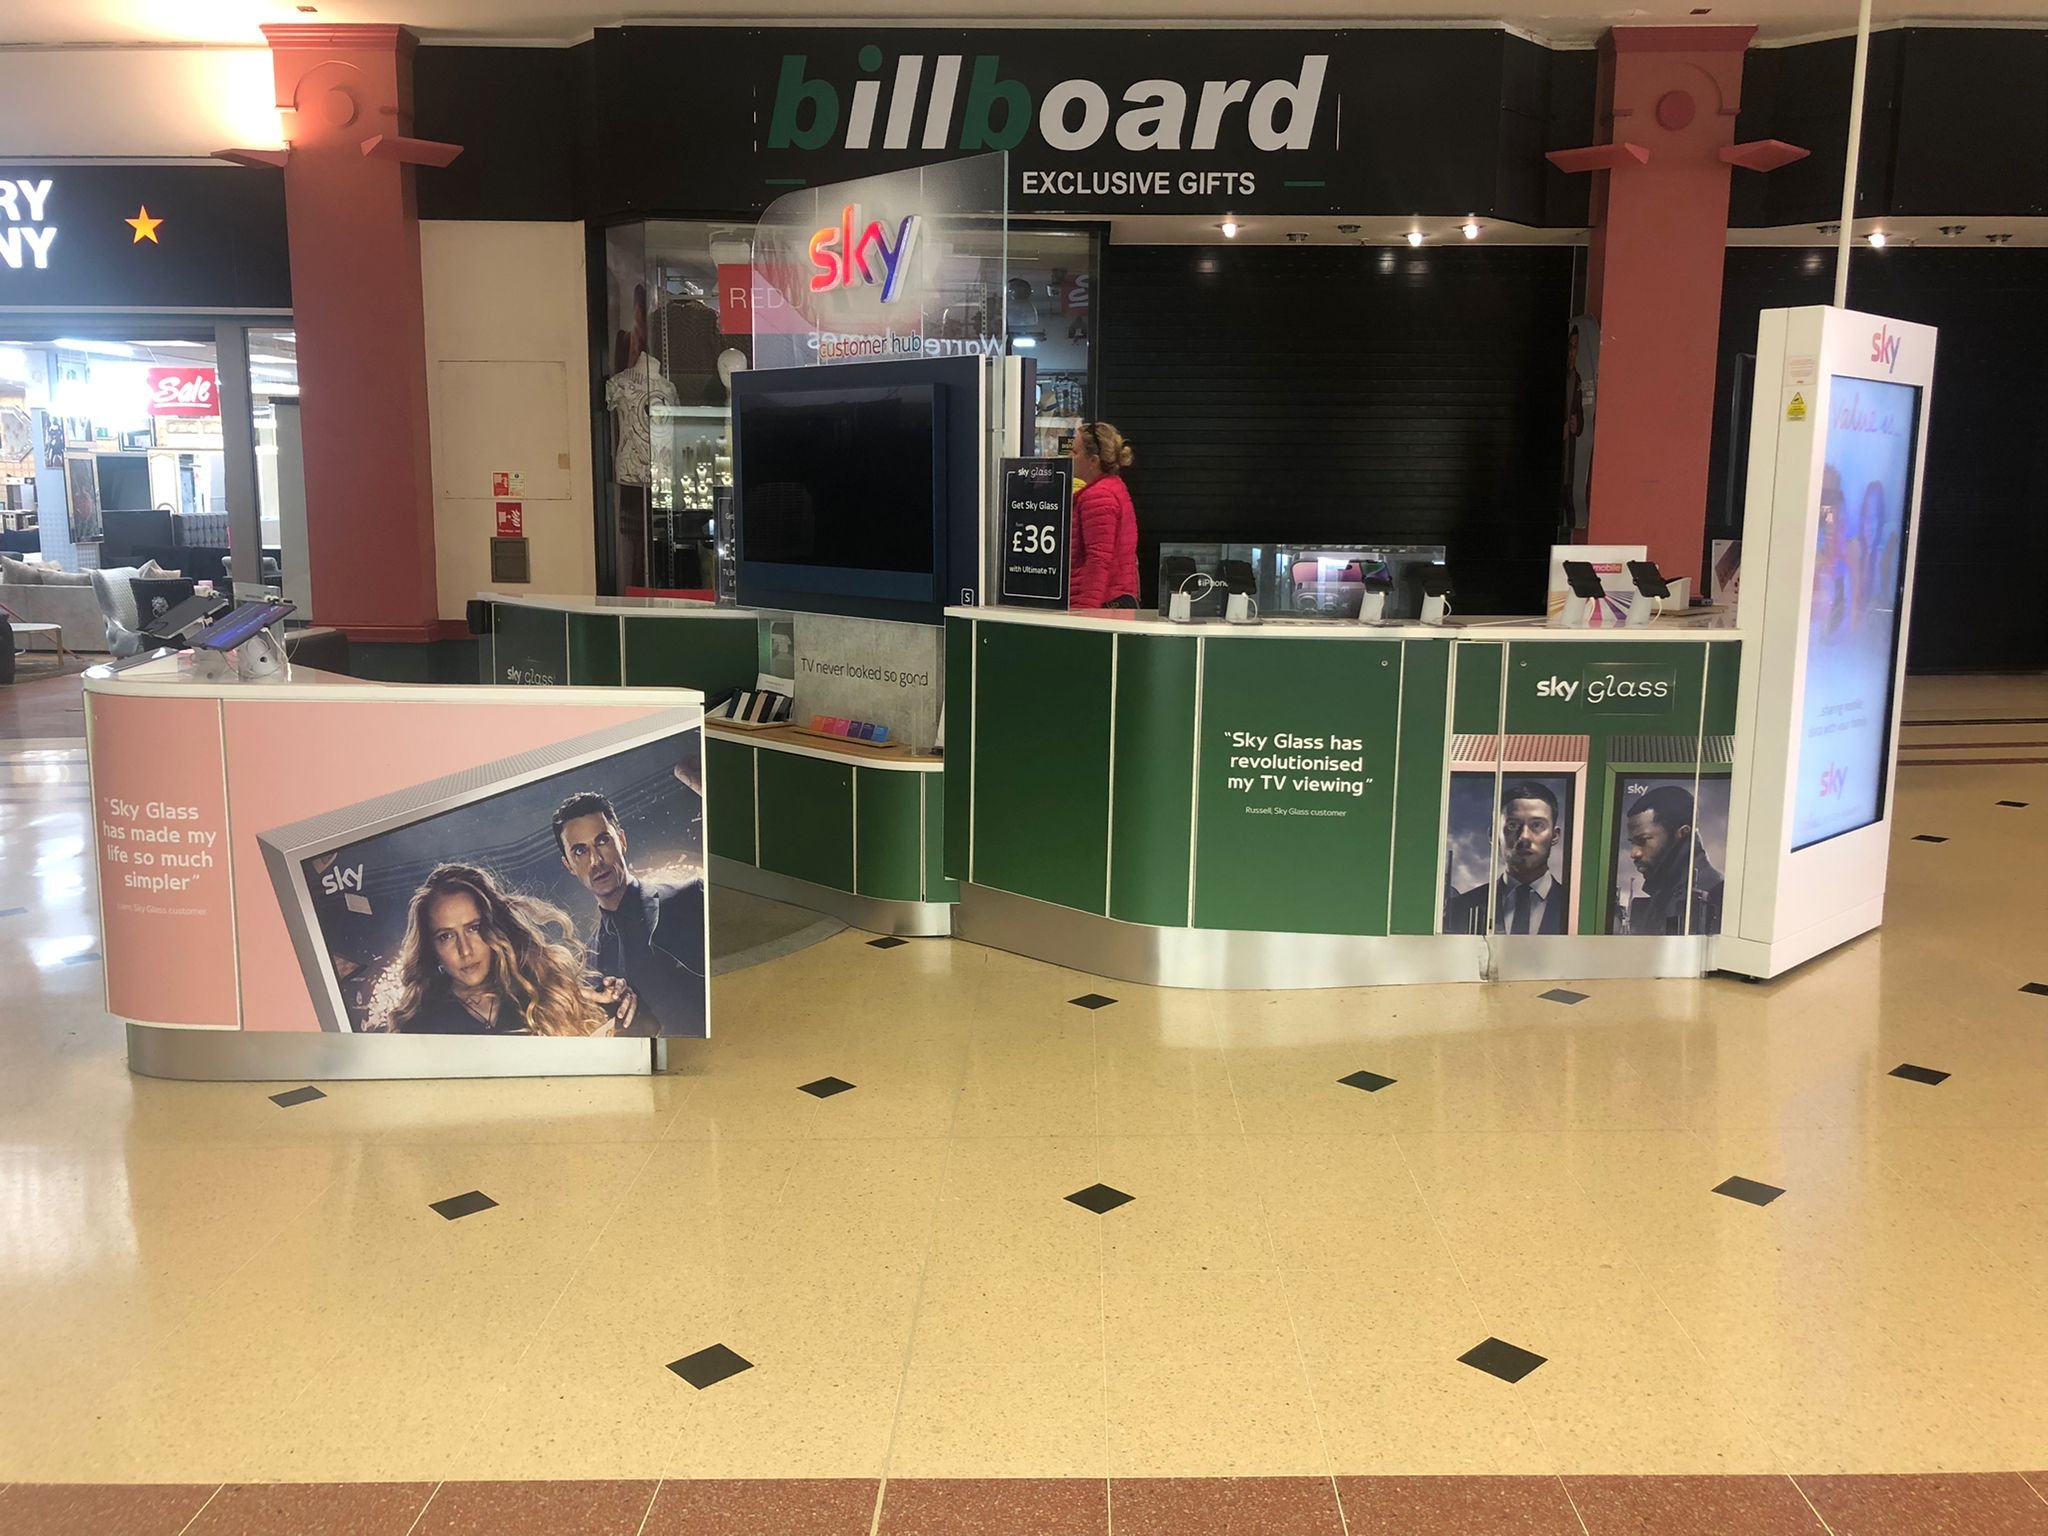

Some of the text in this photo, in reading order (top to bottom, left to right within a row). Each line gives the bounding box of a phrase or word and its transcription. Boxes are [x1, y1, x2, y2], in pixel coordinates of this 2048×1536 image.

[767, 45, 1329, 151] billboard
[1022, 171, 1256, 195] EXCLUSIVE GIFTS
[0, 179, 53, 221] RY
[808, 203, 921, 304] sky
[819, 331, 922, 359] customer hub
[1871, 323, 1901, 374] sky
[153, 375, 212, 402] Sale
[1018, 466, 1052, 479] sky glass
[1011, 500, 1059, 512] Get Sky Glass
[1012, 524, 1056, 554] £36
[1009, 565, 1057, 575] with Ultimate TV
[507, 666, 521, 684] sky
[801, 658, 814, 672] TV
[816, 662, 844, 676] never
[846, 662, 881, 680] looked
[884, 670, 897, 682] so
[1536, 674, 1668, 703] sky glass
[1274, 733, 1324, 750] Glass
[1330, 735, 1363, 751] has
[1230, 754, 1363, 772] revolutionised
[1227, 777, 1254, 792] my
[1260, 775, 1287, 790] TV
[1627, 784, 1648, 796] sky
[146, 802, 199, 820] Glass
[1274, 807, 1288, 816] Sky
[1289, 807, 1309, 816] Glass
[1310, 808, 1347, 817] customer
[103, 820, 216, 848] has made my
[106, 844, 213, 868] life so much
[321, 864, 364, 895] sky
